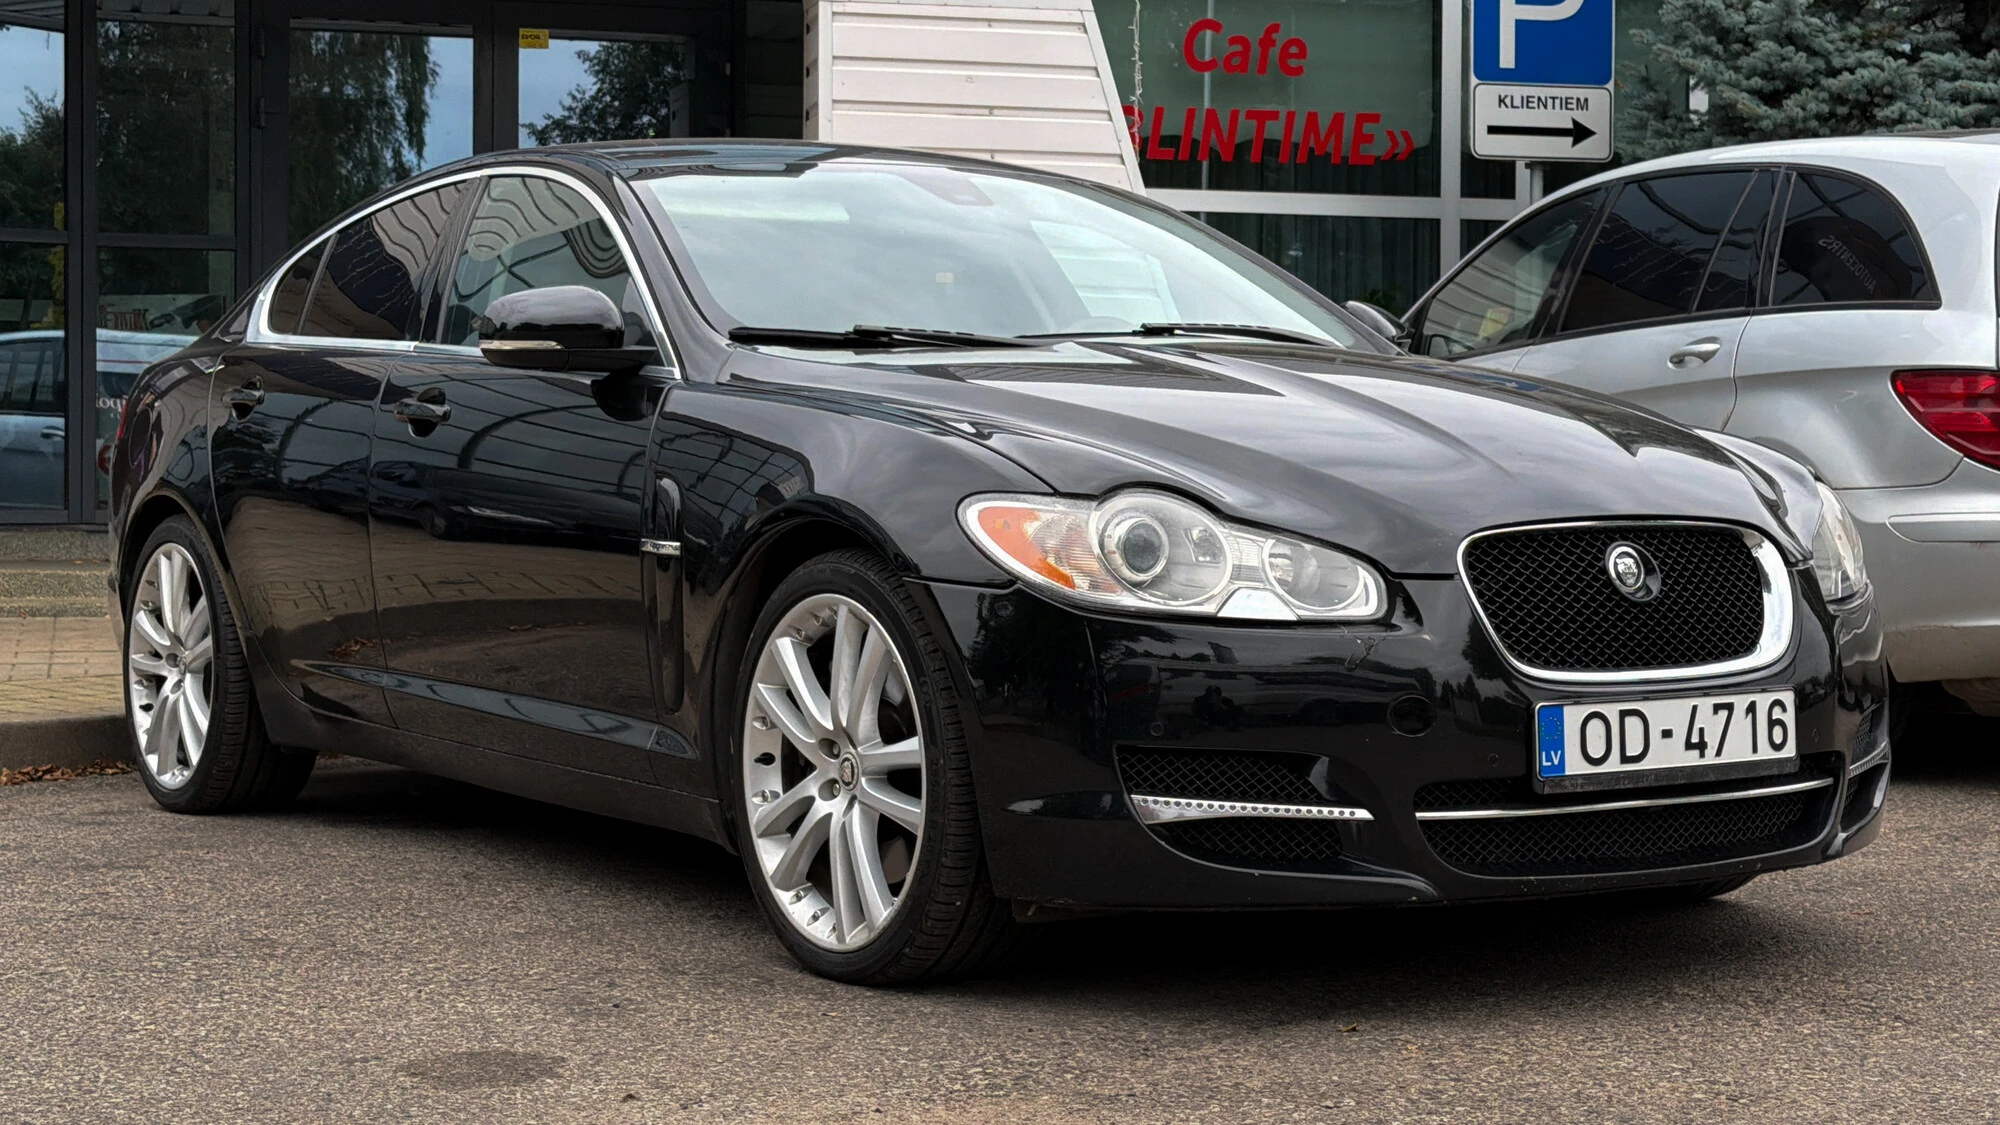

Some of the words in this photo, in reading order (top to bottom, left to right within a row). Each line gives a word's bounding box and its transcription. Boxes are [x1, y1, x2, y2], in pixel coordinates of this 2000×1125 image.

[1183, 17, 1309, 77] Cafe
[1499, 0, 1585, 69] P
[1498, 94, 1589, 112] KLIENTIEM
[1541, 750, 1562, 766] LV
[1580, 698, 1789, 767] OD-4716
